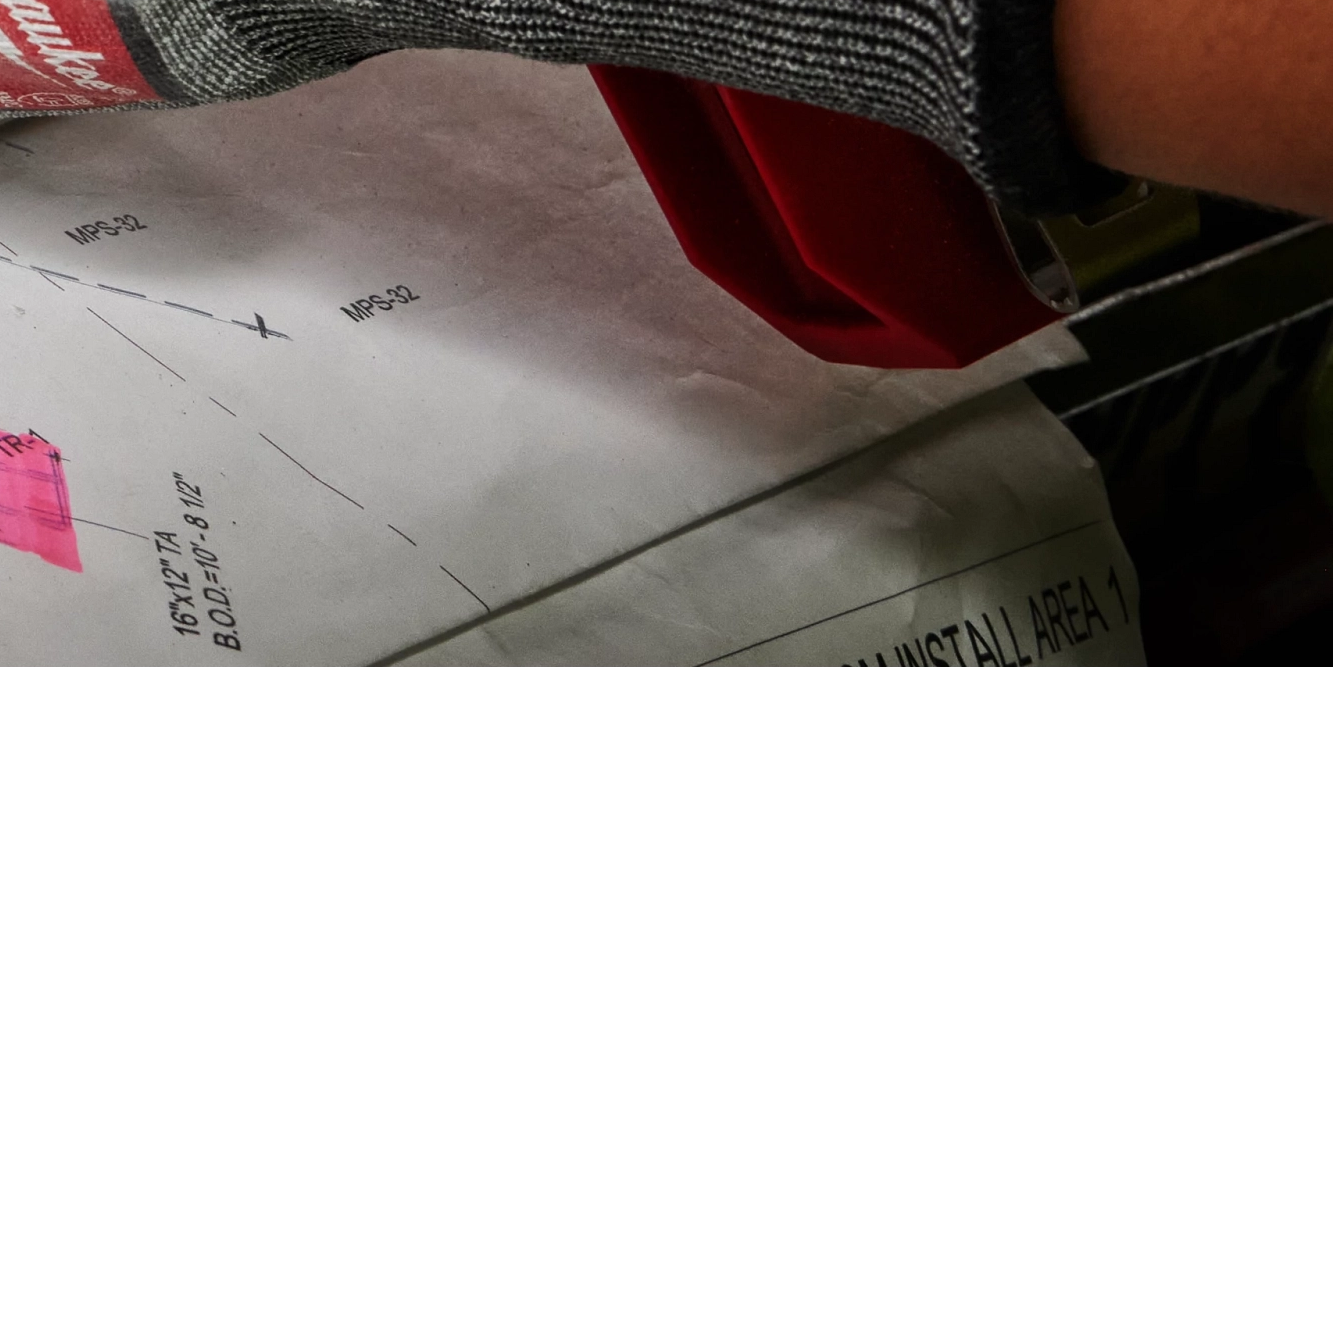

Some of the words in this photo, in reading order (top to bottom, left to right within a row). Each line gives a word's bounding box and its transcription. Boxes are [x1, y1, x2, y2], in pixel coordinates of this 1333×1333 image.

[64, 212, 149, 248] MPS-32
[339, 282, 420, 323] MPS-32
[183, 514, 209, 530] 8
[153, 531, 182, 555] TA
[159, 558, 201, 636] 16"x12"
[1027, 576, 1110, 661] AREA
[1107, 564, 1130, 625] 1
